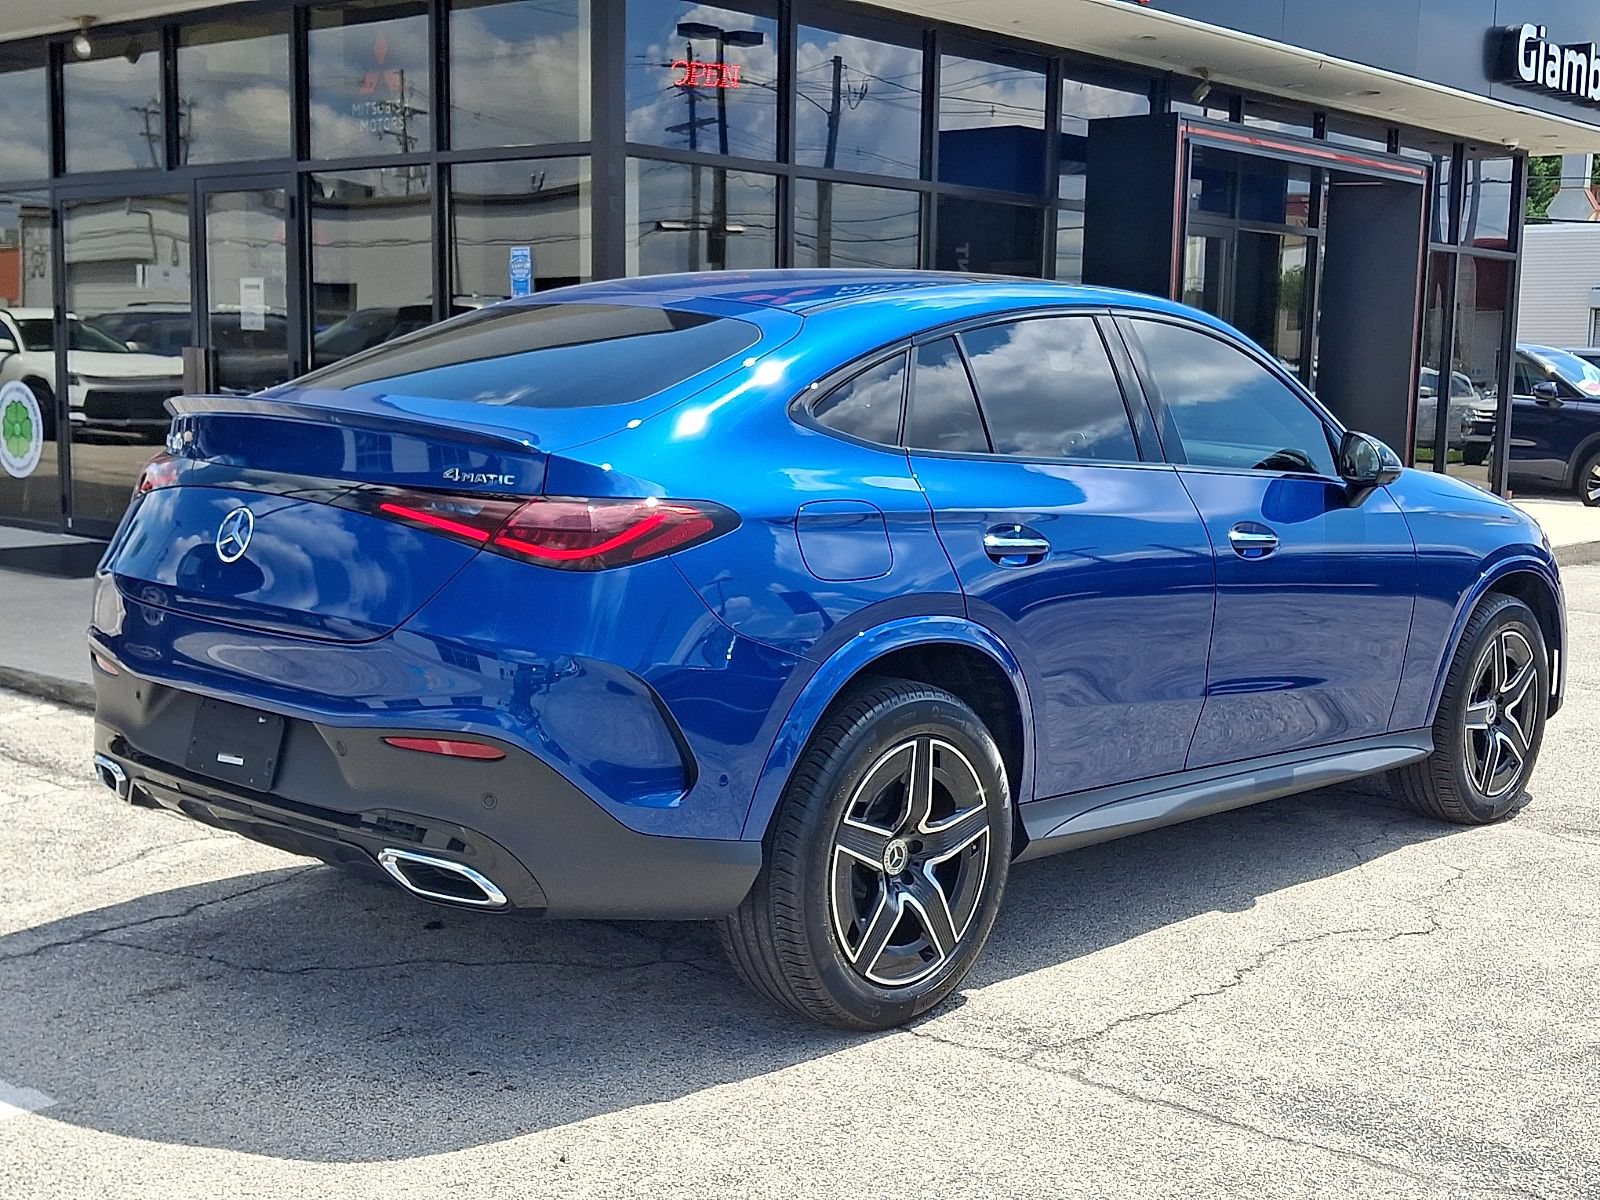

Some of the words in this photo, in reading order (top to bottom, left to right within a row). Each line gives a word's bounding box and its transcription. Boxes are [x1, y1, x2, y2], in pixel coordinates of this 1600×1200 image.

[1518, 23, 1600, 101] Giamb
[671, 60, 740, 87] OPEN
[360, 117, 405, 132] MOTORS
[443, 467, 515, 485] 4MATIC
